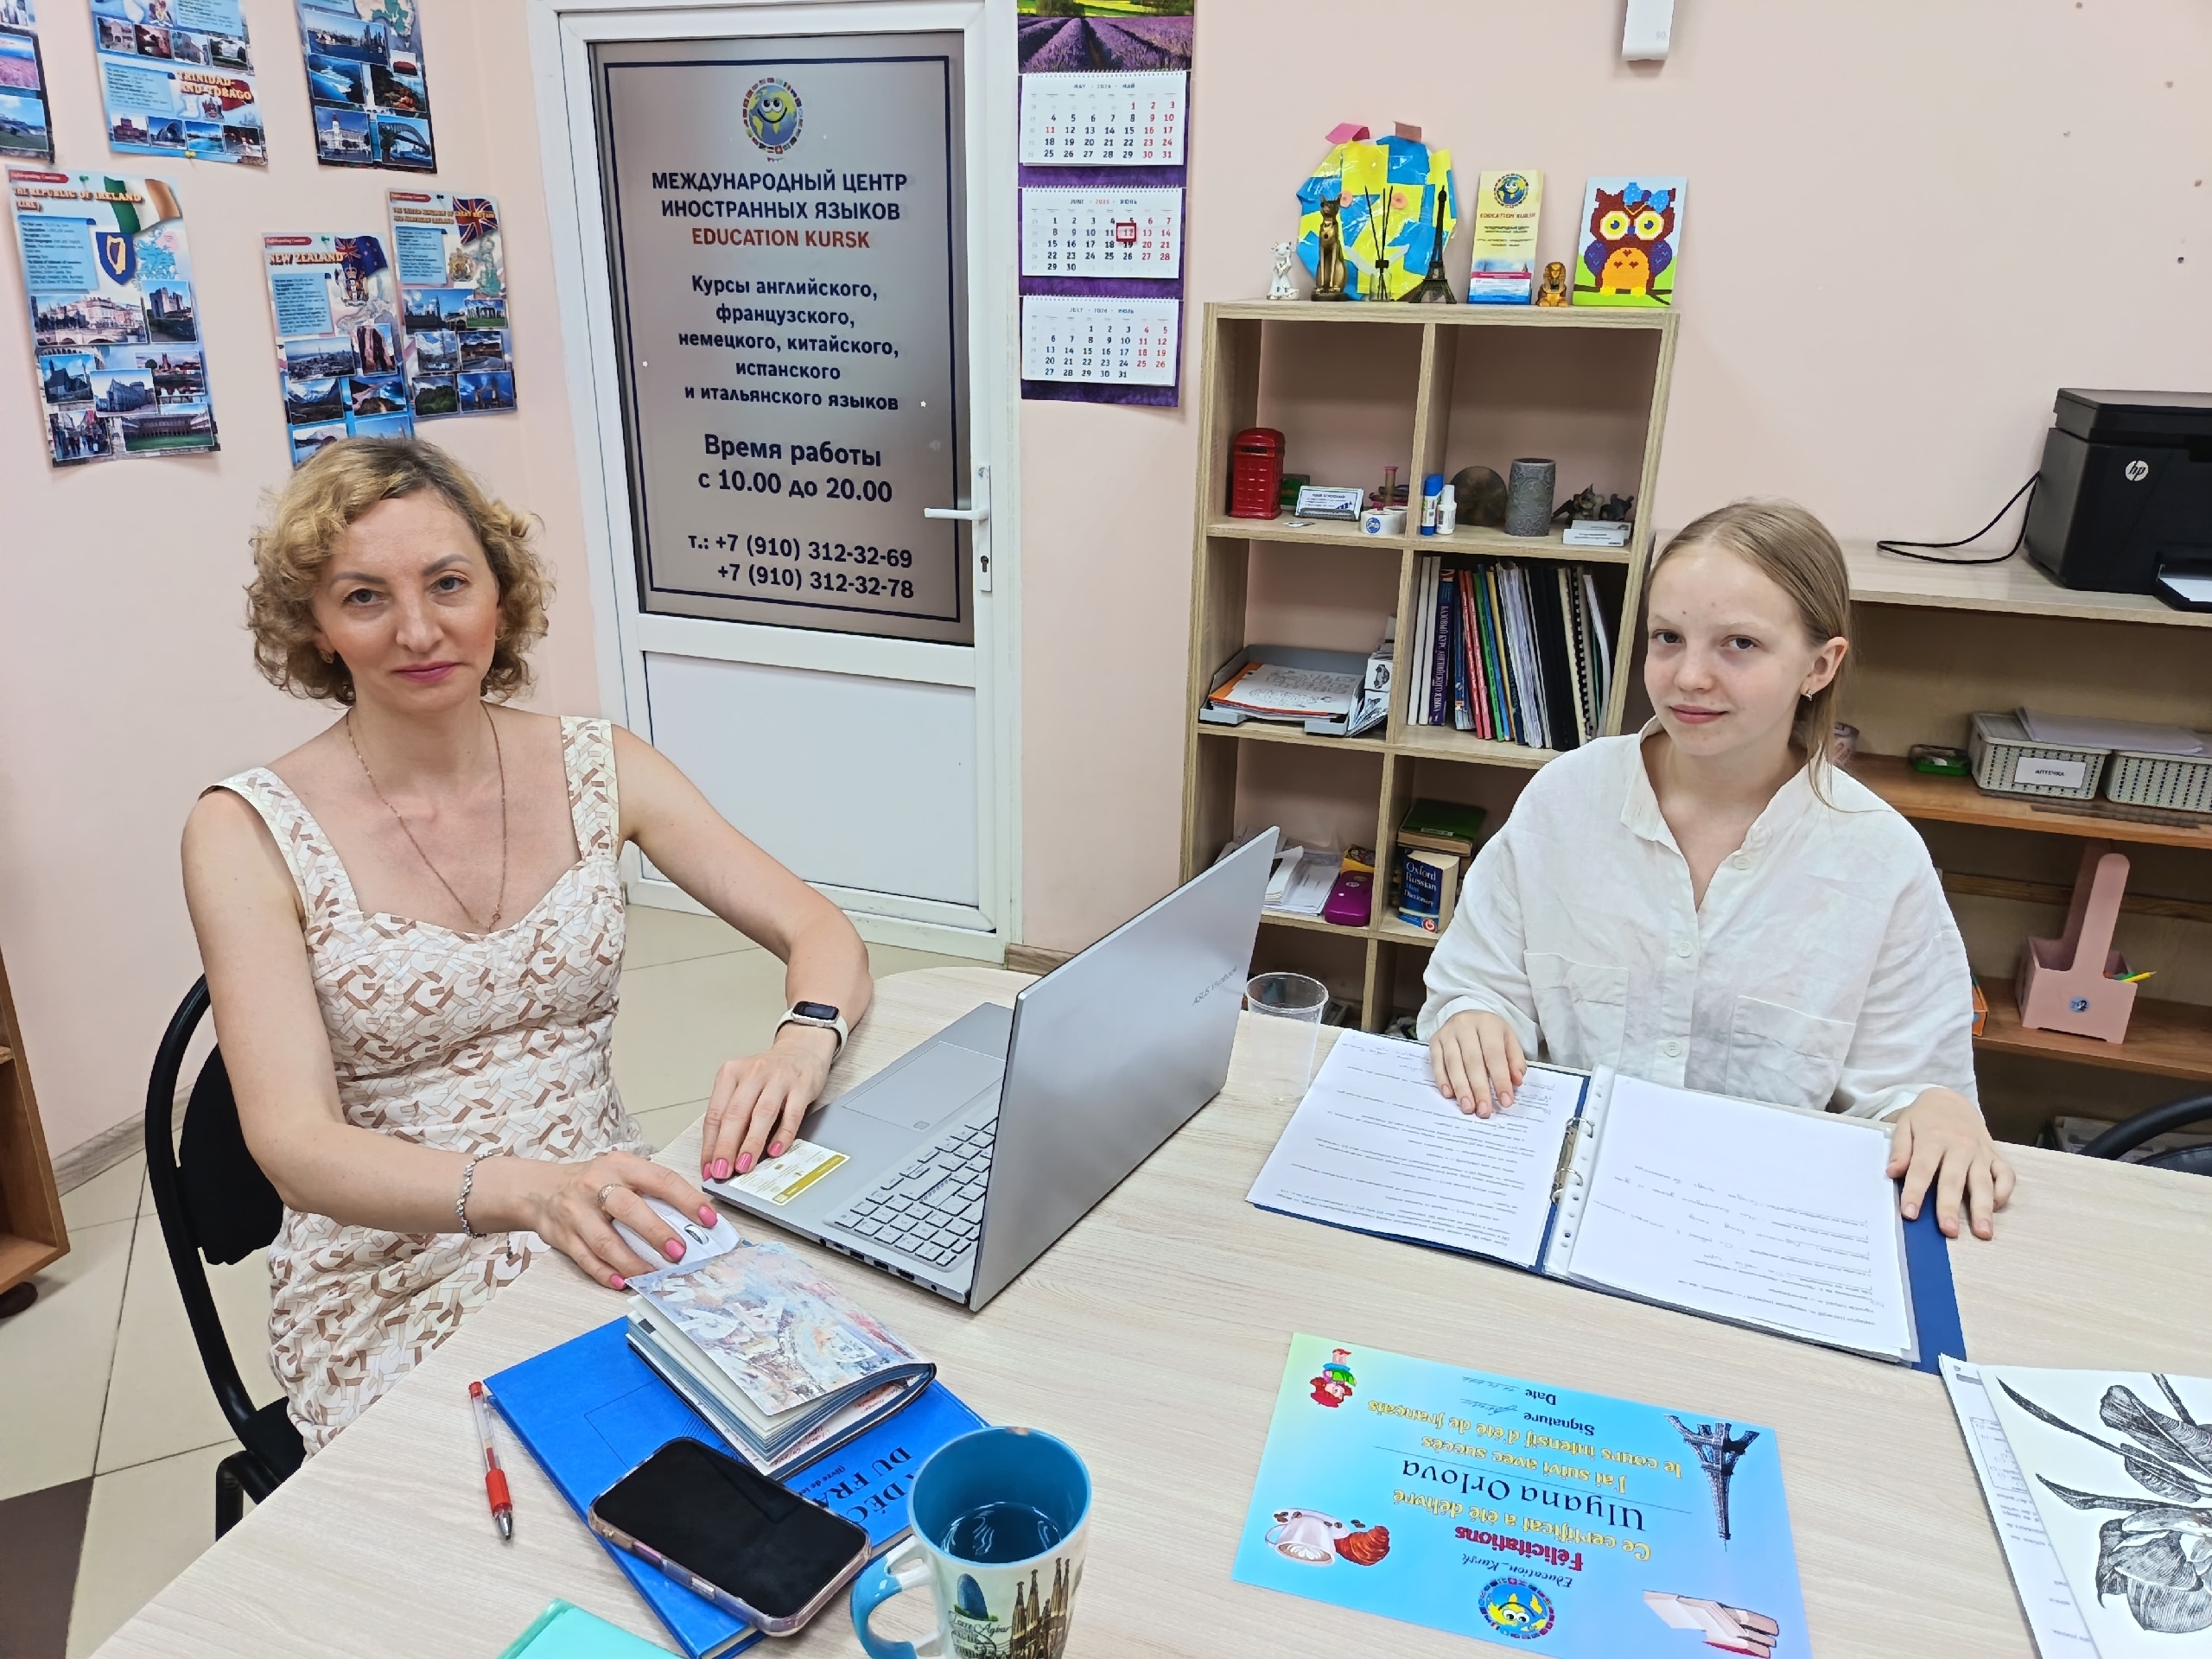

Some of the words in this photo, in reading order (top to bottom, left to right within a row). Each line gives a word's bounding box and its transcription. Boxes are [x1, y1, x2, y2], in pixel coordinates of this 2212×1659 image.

[652, 169, 836, 193] МЕЖДУНАРОДНЫЙ
[842, 174, 907, 194] ЦЕНТР
[661, 200, 809, 219] ИНОСТРАННЫХ
[815, 202, 899, 220] ЯЗЫКОВ
[691, 228, 799, 247] EDUCATION
[805, 231, 870, 249] KURSK
[269, 252, 293, 265] NEW
[296, 251, 347, 264] ZEALAND
[691, 275, 750, 296] Курсы
[757, 278, 878, 301] английского,
[716, 305, 855, 327] французского,
[678, 333, 782, 353] немецкого,
[787, 335, 899, 358] китайского,
[735, 360, 841, 380] испанского
[685, 386, 695, 399] и
[701, 385, 823, 407] итальянского
[828, 395, 899, 411] языков
[704, 434, 782, 461] Время
[791, 441, 881, 467] работы
[2126, 461, 2147, 481] hp
[698, 474, 710, 489] с
[719, 470, 782, 494] 10.00
[788, 480, 818, 498] до
[826, 478, 893, 503] 20.00
[688, 534, 709, 550] т.:
[715, 534, 738, 552] +7
[747, 535, 801, 560] (910)
[808, 542, 913, 569] 312-32-69
[717, 564, 741, 582] +7
[748, 565, 803, 591] (910)
[810, 572, 915, 599] 312-32-78
[1406, 872, 1437, 892] Russian
[1407, 862, 1436, 880] Oxford
[1404, 889, 1434, 908] Dictionary
[1524, 1389, 1556, 1406] Date
[1368, 1400, 1444, 1430] français
[1448, 1417, 1471, 1435] de
[1524, 1412, 1595, 1436] Signature
[1477, 1422, 1521, 1445] d'été
[1526, 1429, 1595, 1460] intensif
[1421, 1435, 1487, 1459] succès
[1601, 1447, 1659, 1468] cours
[872, 1446, 912, 1478] DU
[1491, 1452, 1537, 1469] avec
[1543, 1459, 1590, 1481] suivi
[1664, 1460, 1681, 1478] le
[813, 1471, 870, 1509] FRA
[1402, 1460, 1510, 1500] Orlova
[1595, 1471, 1626, 1494] J'ai
[847, 1482, 907, 1523] DÉC
[1393, 1490, 1463, 1518] délivré
[1521, 1484, 1646, 1531] Ulyana
[1469, 1506, 1498, 1526] été
[1503, 1512, 1517, 1526] a
[1522, 1516, 1617, 1548] certificat
[1455, 1526, 1583, 1572] Félicitations
[1622, 1540, 1651, 1560] Ce
